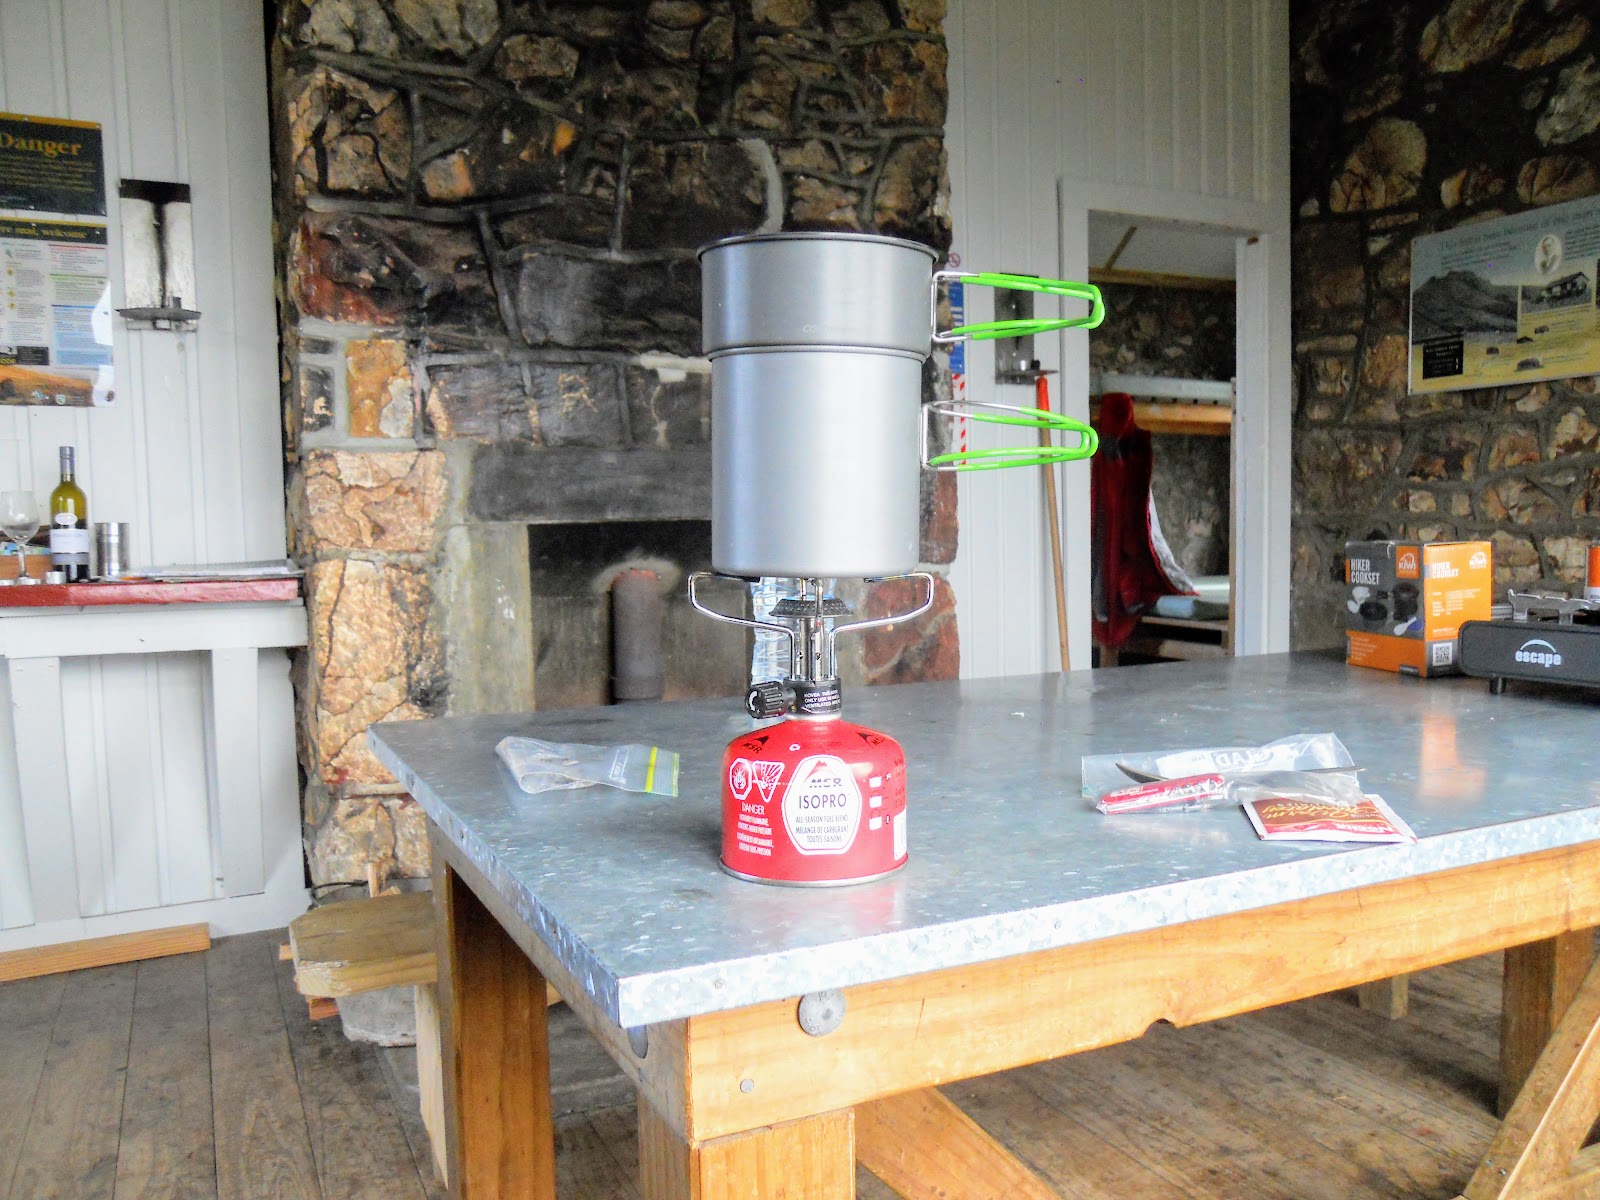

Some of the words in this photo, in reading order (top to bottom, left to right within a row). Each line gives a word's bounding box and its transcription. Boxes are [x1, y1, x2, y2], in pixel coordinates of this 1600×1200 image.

[0, 132, 82, 157] Danger
[1350, 558, 1371, 572] HIKER
[1350, 571, 1380, 586] COOKSET
[1515, 650, 1562, 667] escape
[743, 742, 763, 754] MSR
[741, 802, 765, 815] DANGER
[798, 793, 847, 809] ISOPRO
